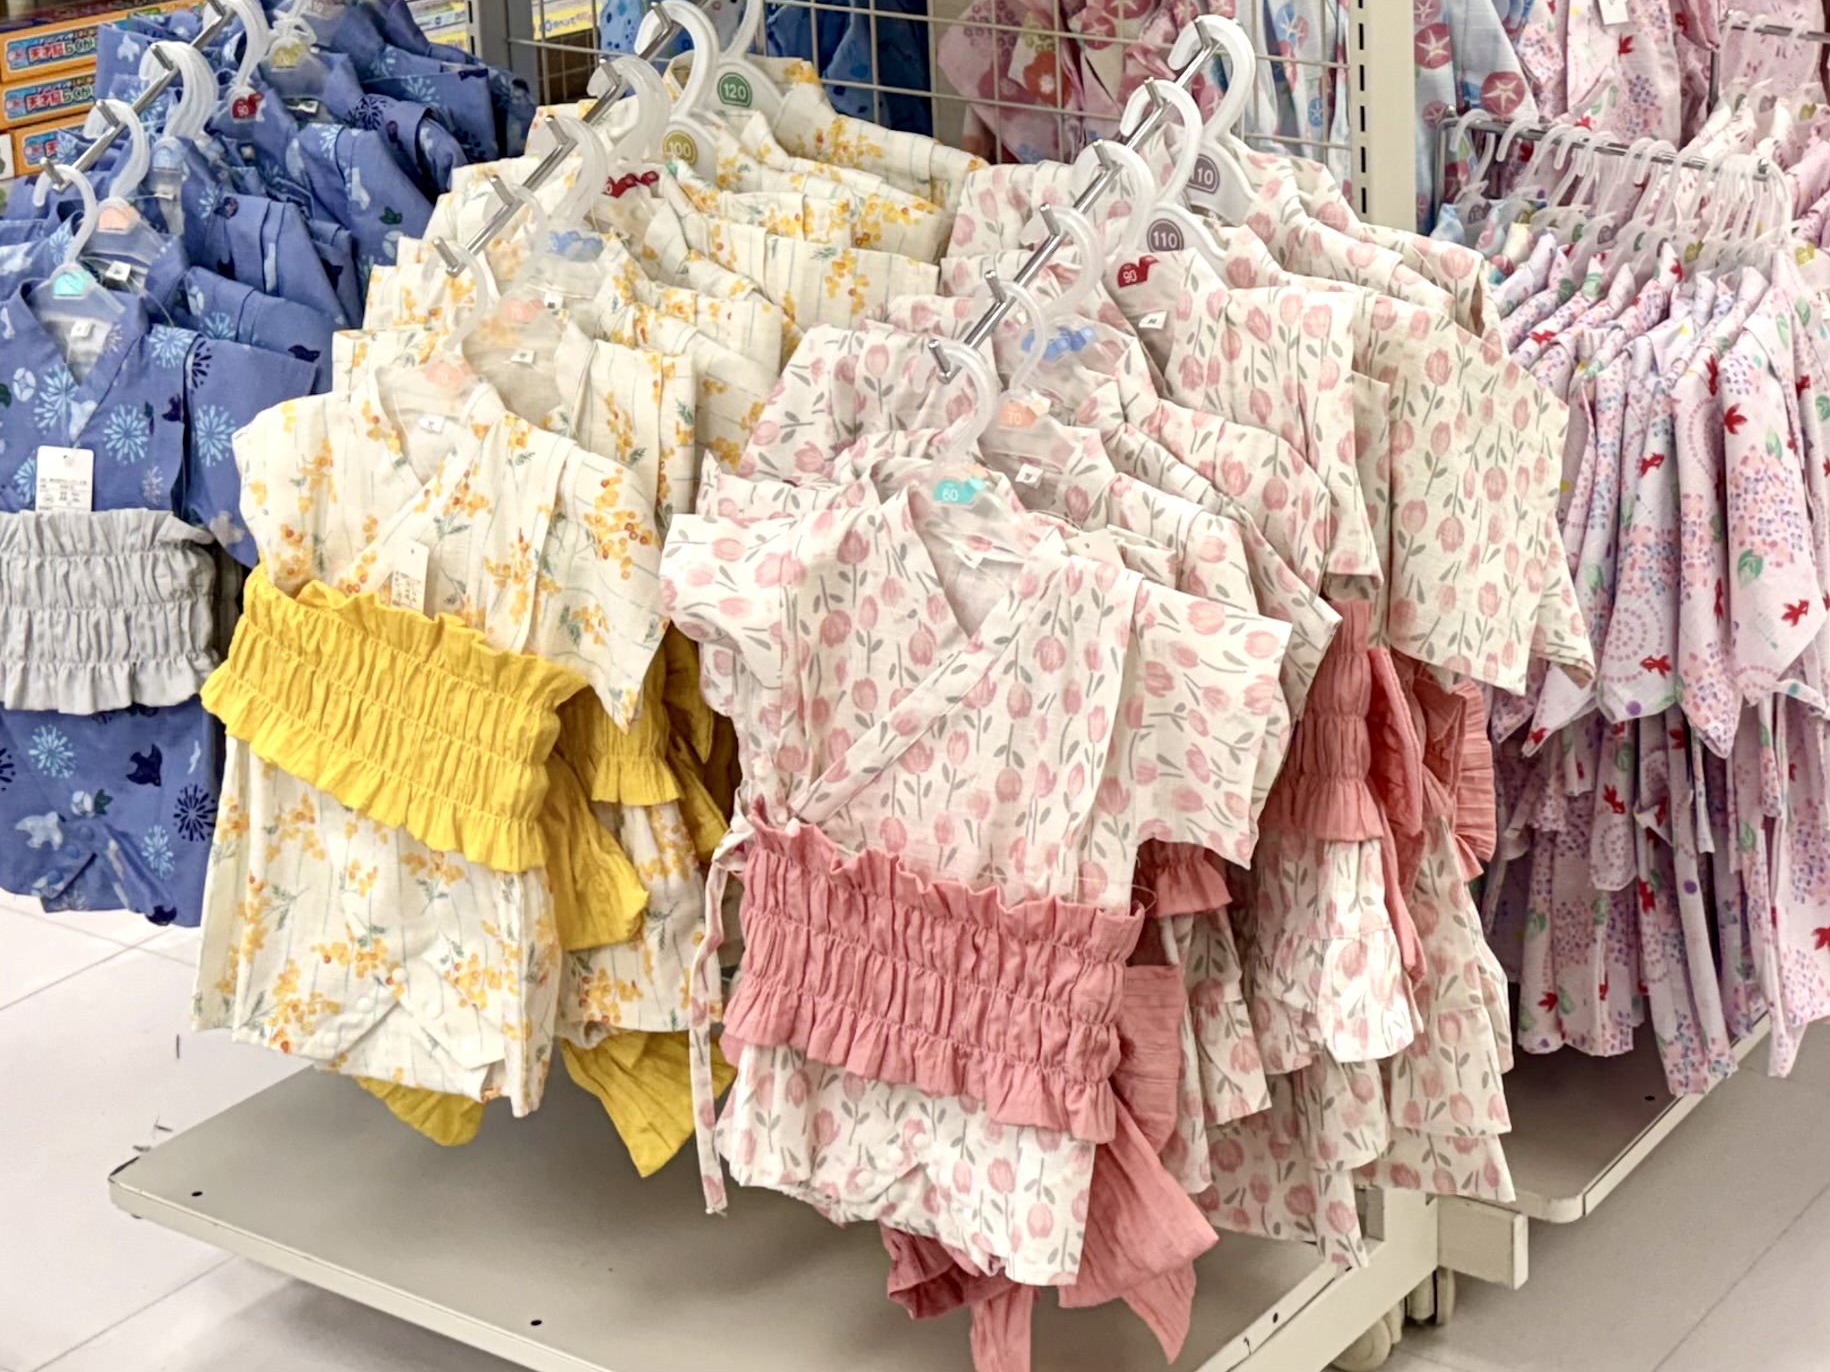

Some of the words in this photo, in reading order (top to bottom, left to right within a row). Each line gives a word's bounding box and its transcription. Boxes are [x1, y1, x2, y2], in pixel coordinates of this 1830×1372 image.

[723, 83, 747, 100] 120
[668, 141, 692, 157] 100
[1152, 230, 1178, 249] 110
[1122, 271, 1138, 284] 90
[1007, 412, 1022, 426] 70
[942, 488, 959, 502] 60
